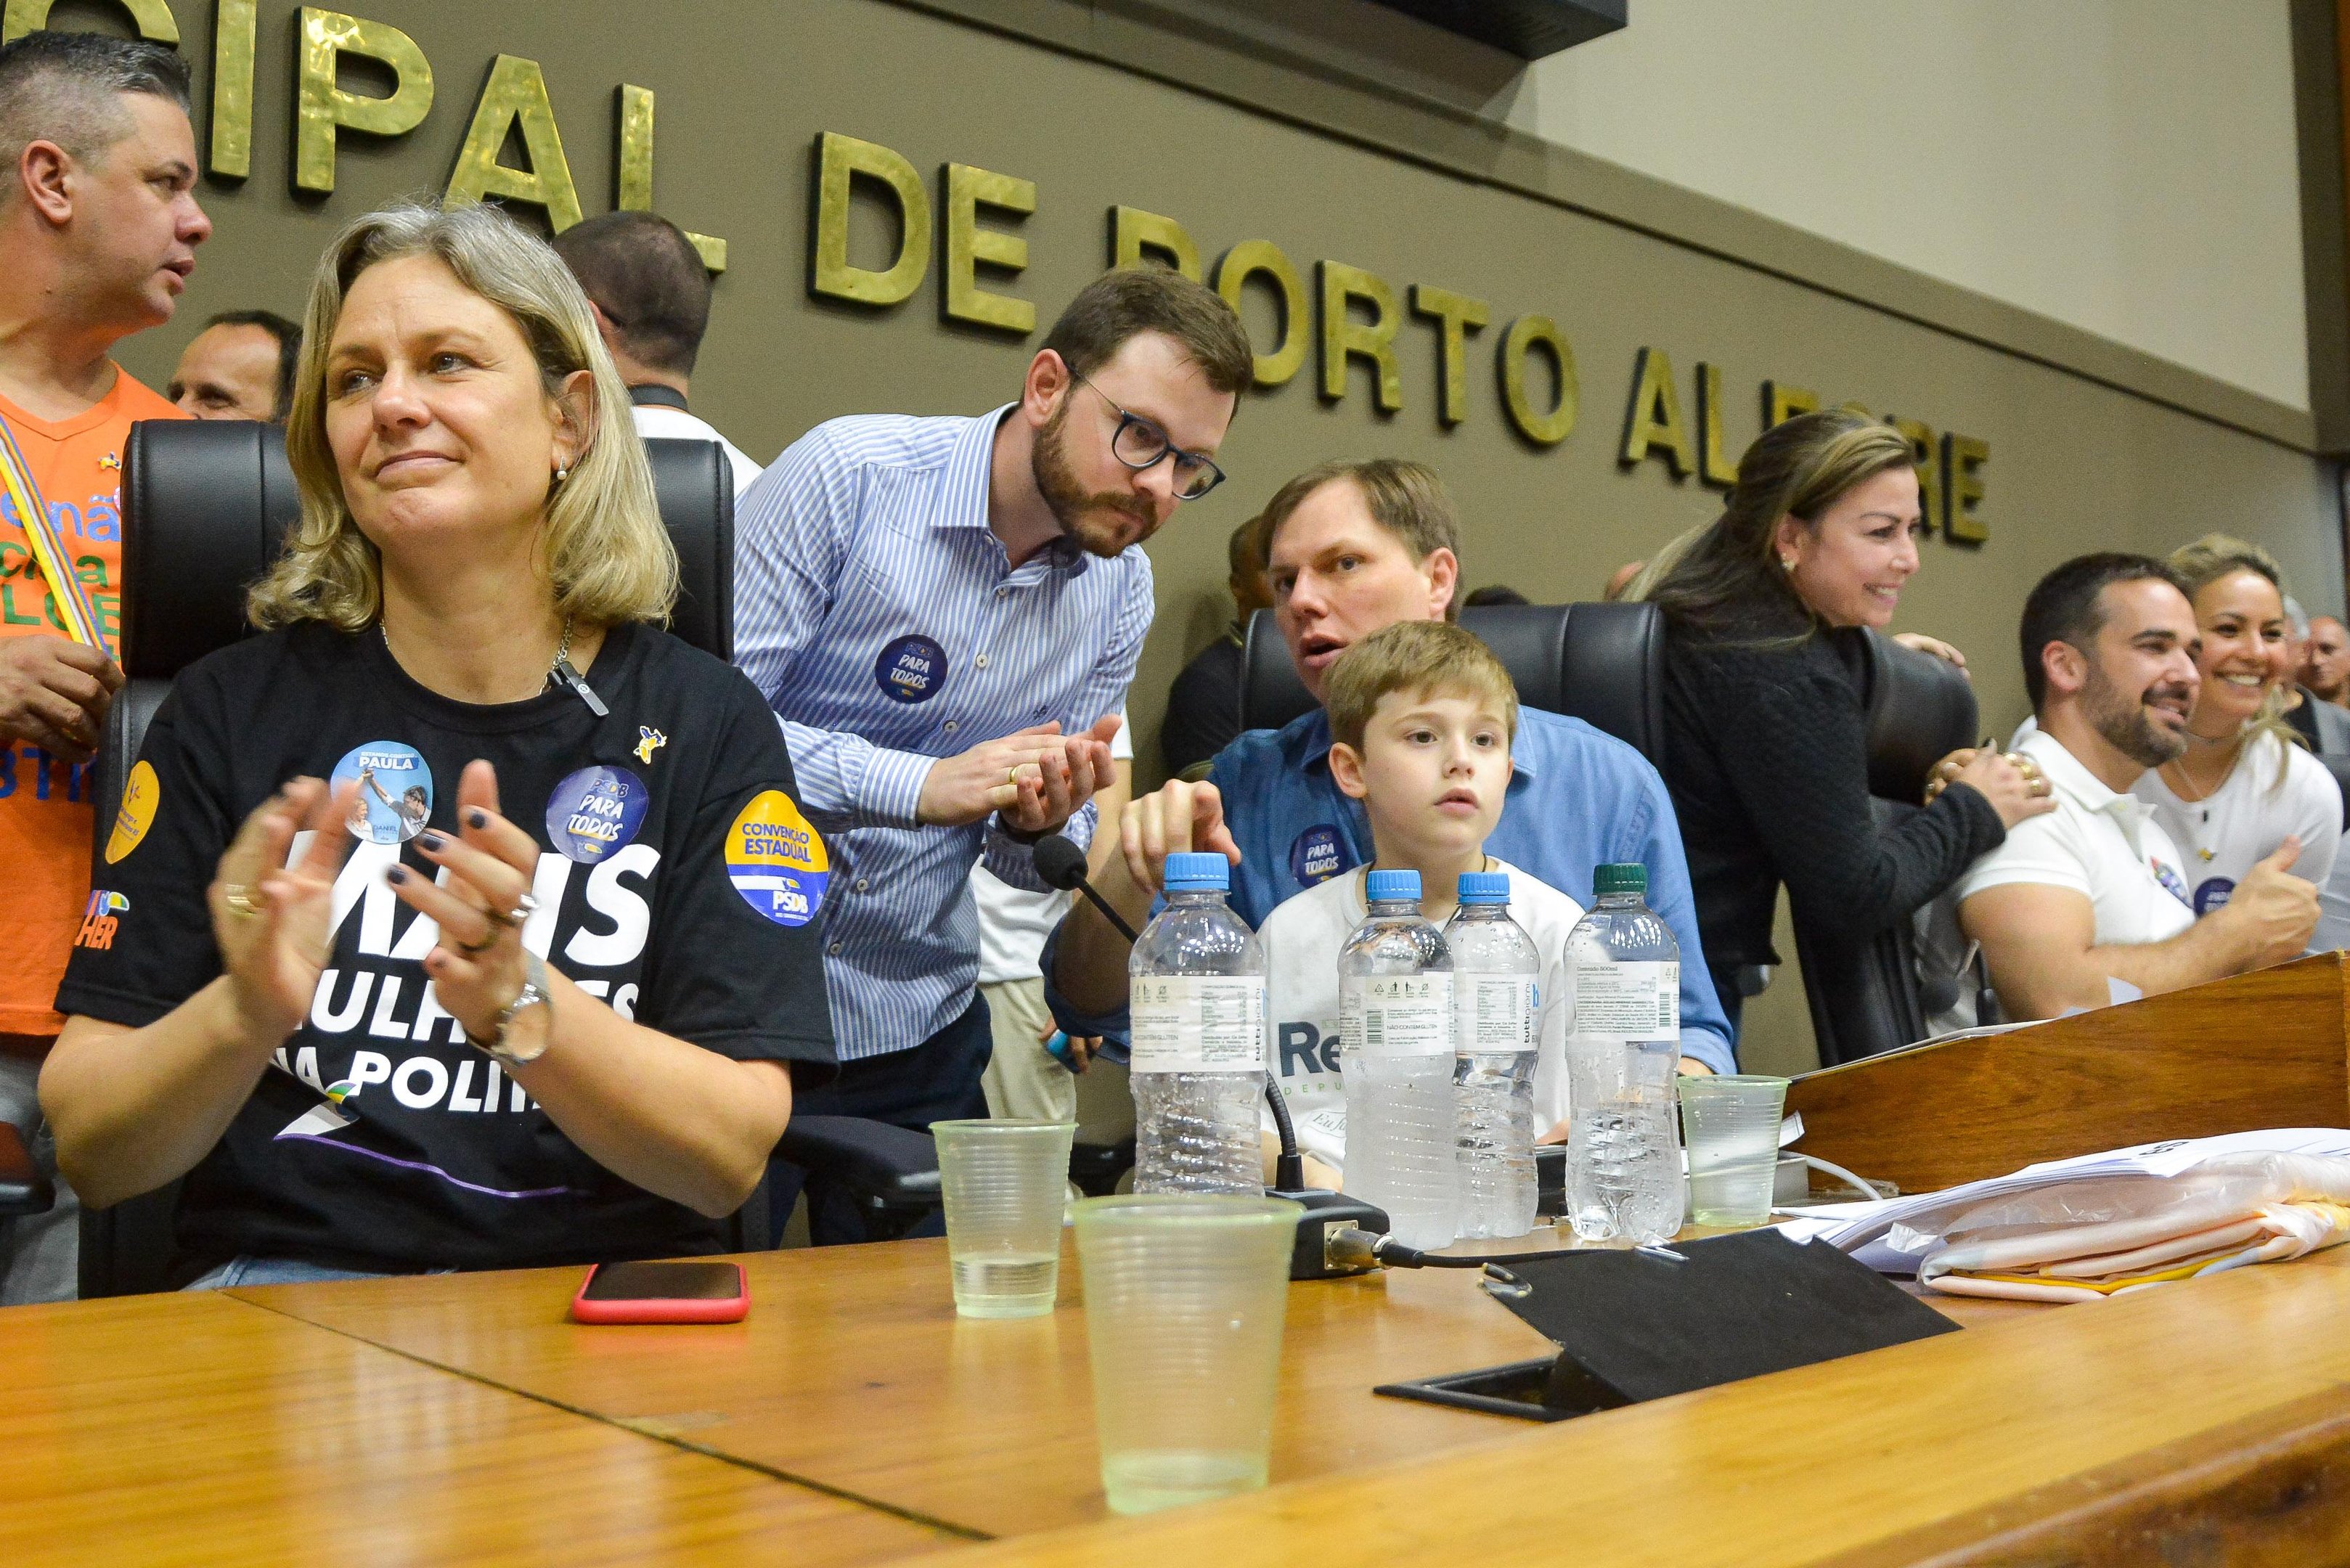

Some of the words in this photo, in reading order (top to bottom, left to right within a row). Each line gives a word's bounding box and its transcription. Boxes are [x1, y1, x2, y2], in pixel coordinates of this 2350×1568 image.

[812, 131, 1036, 335] DE
[898, 654, 930, 674] PARA
[889, 667, 930, 689] TODOS
[359, 756, 414, 770] PAULA
[589, 778, 629, 798] PSDB
[579, 794, 624, 820] PARA
[568, 813, 624, 841] TODOS
[741, 822, 809, 844] CONVENÇÃO
[744, 838, 812, 862] ESTADUAL
[1307, 843, 1335, 859] PARA
[1305, 856, 1339, 873] TODOS
[772, 890, 809, 914] PSDB
